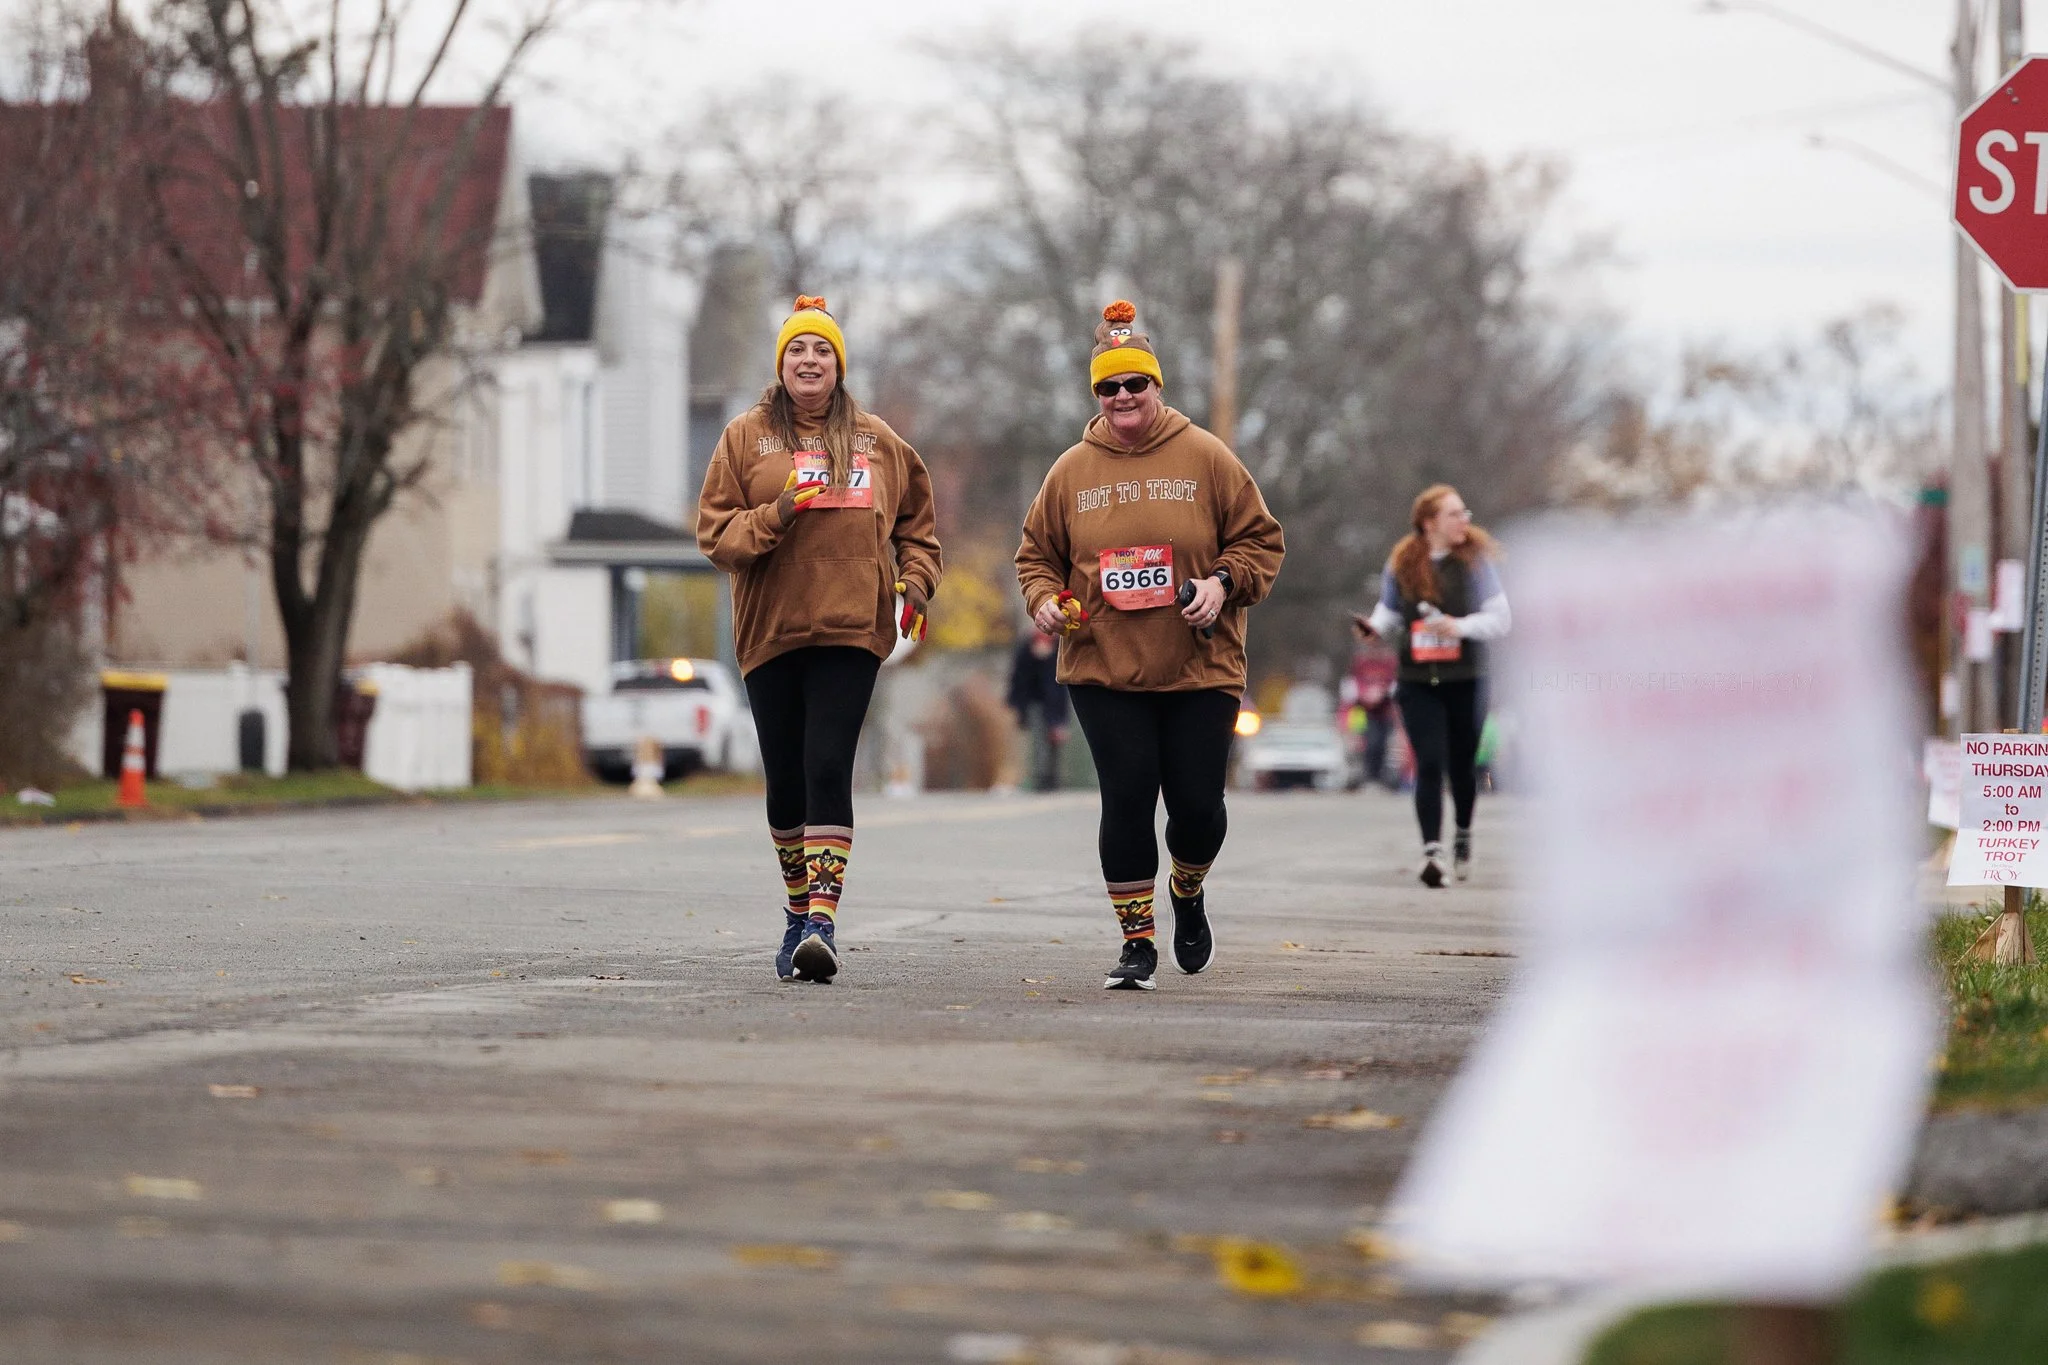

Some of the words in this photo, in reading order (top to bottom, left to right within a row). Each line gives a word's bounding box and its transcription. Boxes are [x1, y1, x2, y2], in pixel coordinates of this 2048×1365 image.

[758, 436, 787, 456] HO
[800, 436, 825, 451] TO
[802, 471, 864, 487] 707
[1077, 485, 1111, 513] HOT
[1117, 480, 1140, 503] TO
[1147, 479, 1196, 502] TROT
[1143, 548, 1164, 561] 10K
[1106, 568, 1167, 590] 6966
[1967, 742, 1989, 755] NO
[1983, 785, 2014, 798] 5:00
[2017, 785, 2041, 799] AM
[2004, 803, 2019, 815] to
[1983, 819, 2013, 832] 2:00
[2017, 820, 2041, 832] PM
[1977, 838, 2040, 850] TURKEY
[1984, 851, 2027, 862] TROT
[1983, 869, 2022, 882] TROY
